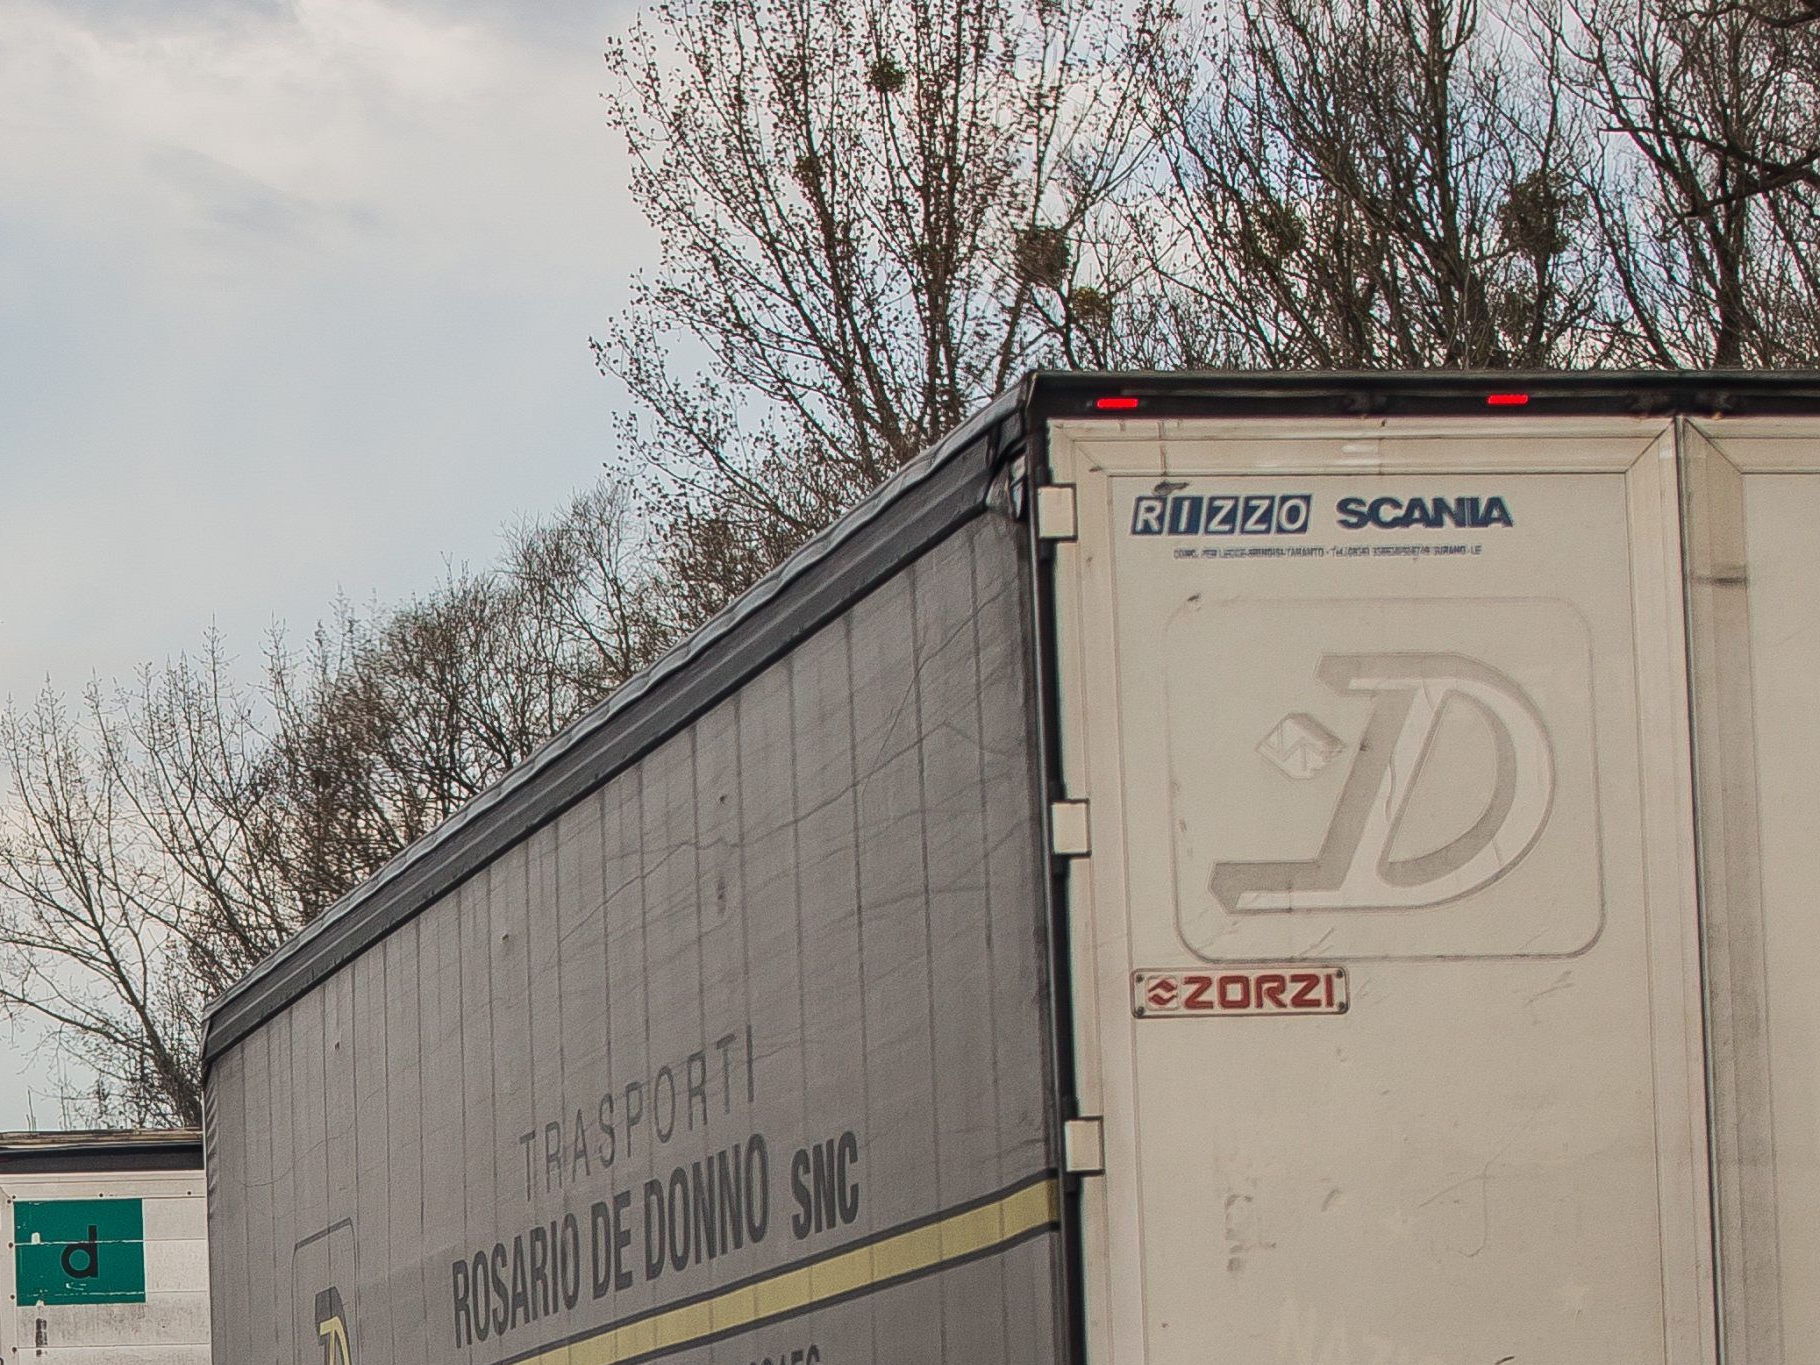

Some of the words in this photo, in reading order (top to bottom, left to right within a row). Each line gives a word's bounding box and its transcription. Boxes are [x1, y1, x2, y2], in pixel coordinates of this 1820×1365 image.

[1132, 494, 1311, 536] RIZZO
[1336, 496, 1513, 530] SCANIA
[1183, 974, 1335, 1010] ZORZI
[519, 1023, 755, 1202] TRASPORTI
[61, 1224, 99, 1280] d
[451, 1213, 581, 1349] ROSARIO
[590, 1190, 633, 1300] DE
[643, 1133, 770, 1282] DONNO
[790, 1130, 860, 1241] SNC
